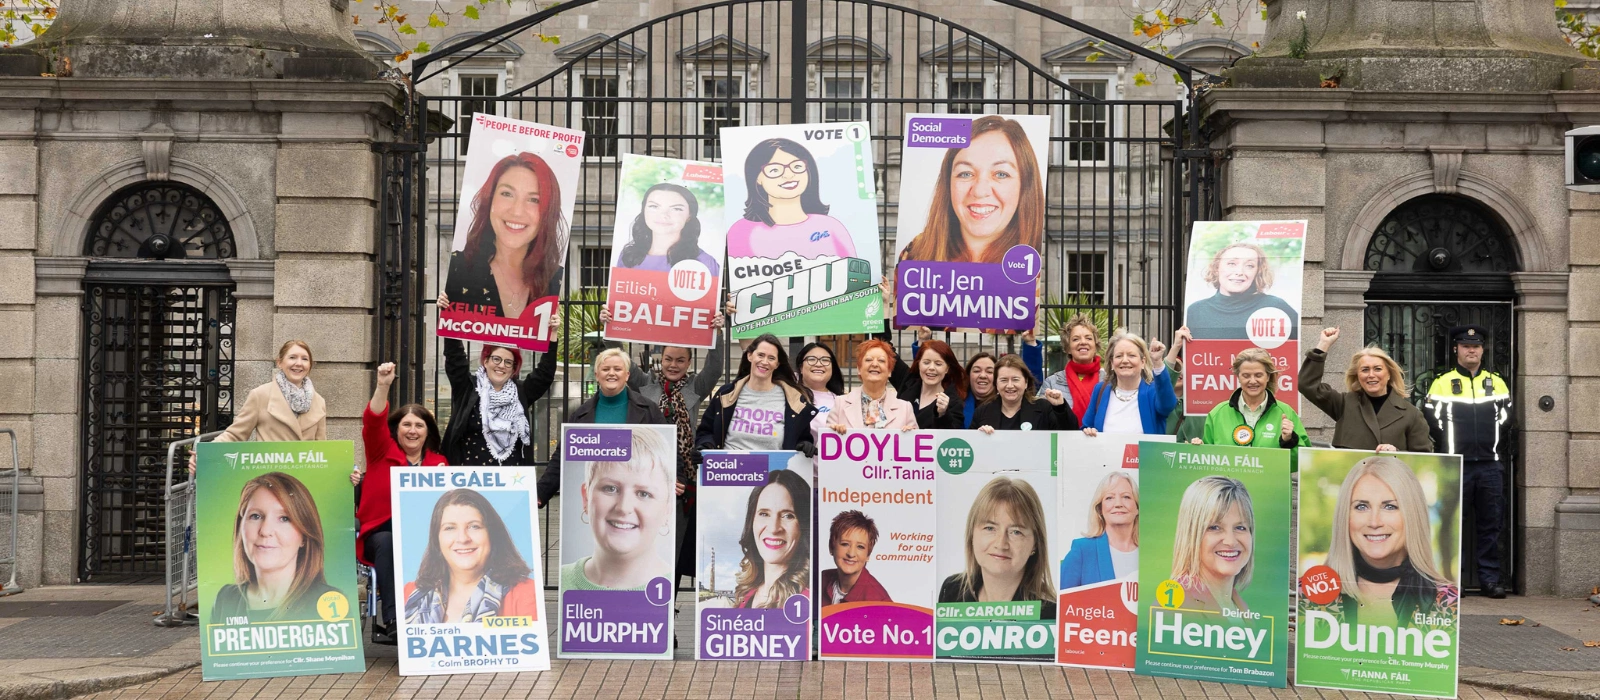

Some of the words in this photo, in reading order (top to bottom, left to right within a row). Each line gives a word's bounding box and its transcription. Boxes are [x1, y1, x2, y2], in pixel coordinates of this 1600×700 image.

[486, 120, 517, 132] PEOPLE
[519, 126, 550, 139] BEFORE
[553, 132, 582, 144] PROFIT
[804, 129, 843, 140] VOTE
[853, 128, 859, 138] 1
[912, 122, 942, 132] Social
[912, 133, 966, 144] Democrats
[734, 259, 803, 278] CHOOSE
[1024, 253, 1034, 276] 1
[674, 269, 697, 290] VOTE
[699, 272, 705, 290] 1
[904, 267, 944, 290] Cllr.
[947, 269, 984, 294] Jen
[615, 281, 657, 296] Eilish
[734, 257, 848, 325] CHU
[445, 301, 496, 316] KELLIE
[736, 323, 755, 333] VOTE
[756, 316, 779, 328] HAZEL
[780, 311, 796, 321] CHU
[796, 307, 812, 317] FOR
[812, 300, 838, 311] DUBLIN
[839, 295, 854, 304] BAY
[854, 287, 879, 300] SOUTH
[902, 292, 1029, 320] CUMMINS
[438, 318, 537, 339] McCONNELL
[534, 301, 552, 341] 1
[614, 300, 710, 329] BALFE
[1252, 318, 1276, 337] VOTE
[1279, 318, 1285, 337] 1
[1192, 353, 1223, 366] Cllr.
[735, 407, 783, 423] more
[570, 434, 600, 444] Social
[570, 446, 627, 456] Democrats
[821, 433, 934, 462] DOYLE
[940, 448, 970, 457] VOTE
[241, 452, 294, 464] FIANNA
[299, 450, 328, 463] FÁIL
[706, 459, 737, 469] Social
[949, 459, 962, 468] #1
[1178, 453, 1230, 466] FIANNA
[1234, 454, 1263, 468] FÁIL
[400, 472, 446, 487] FINE
[451, 472, 506, 487] GAEL
[706, 471, 764, 481] Democrats
[823, 487, 933, 506] Independent
[890, 532, 933, 542] Working
[898, 543, 913, 551] for
[876, 554, 933, 563] community
[1307, 572, 1328, 583] VOTE
[655, 583, 663, 599] 1
[1305, 578, 1340, 597] NO.1
[1164, 588, 1175, 608] 1
[328, 601, 340, 618] 1
[566, 603, 602, 619] Ellen
[794, 601, 801, 617] 1
[936, 606, 962, 617] Cllr.
[966, 605, 1034, 617] CAROLINE
[1065, 604, 1115, 620] Angela
[1222, 607, 1260, 620] Deirdre
[226, 616, 248, 626] LYNDA
[486, 618, 519, 627] VOTE
[523, 618, 528, 626] 1
[706, 614, 764, 631] Sinéad
[1414, 613, 1451, 626] Elaine
[214, 622, 349, 652] PRENDERGAST
[406, 627, 427, 636] Cllr.
[430, 626, 460, 635] Sarah
[565, 622, 664, 643] MURPHY
[823, 623, 875, 644] Vote
[1155, 611, 1267, 658] Heney
[1304, 610, 1451, 658] Dunne
[407, 633, 539, 658] BARNES
[706, 634, 801, 657] GIBNEY
[464, 658, 503, 666] BROPHY
[1401, 660, 1424, 668] Tommy
[1425, 662, 1449, 670] Murphy
[1244, 668, 1274, 676] Brabazon
[1352, 669, 1388, 680] FIANNA
[1391, 672, 1410, 682] FÁIL
